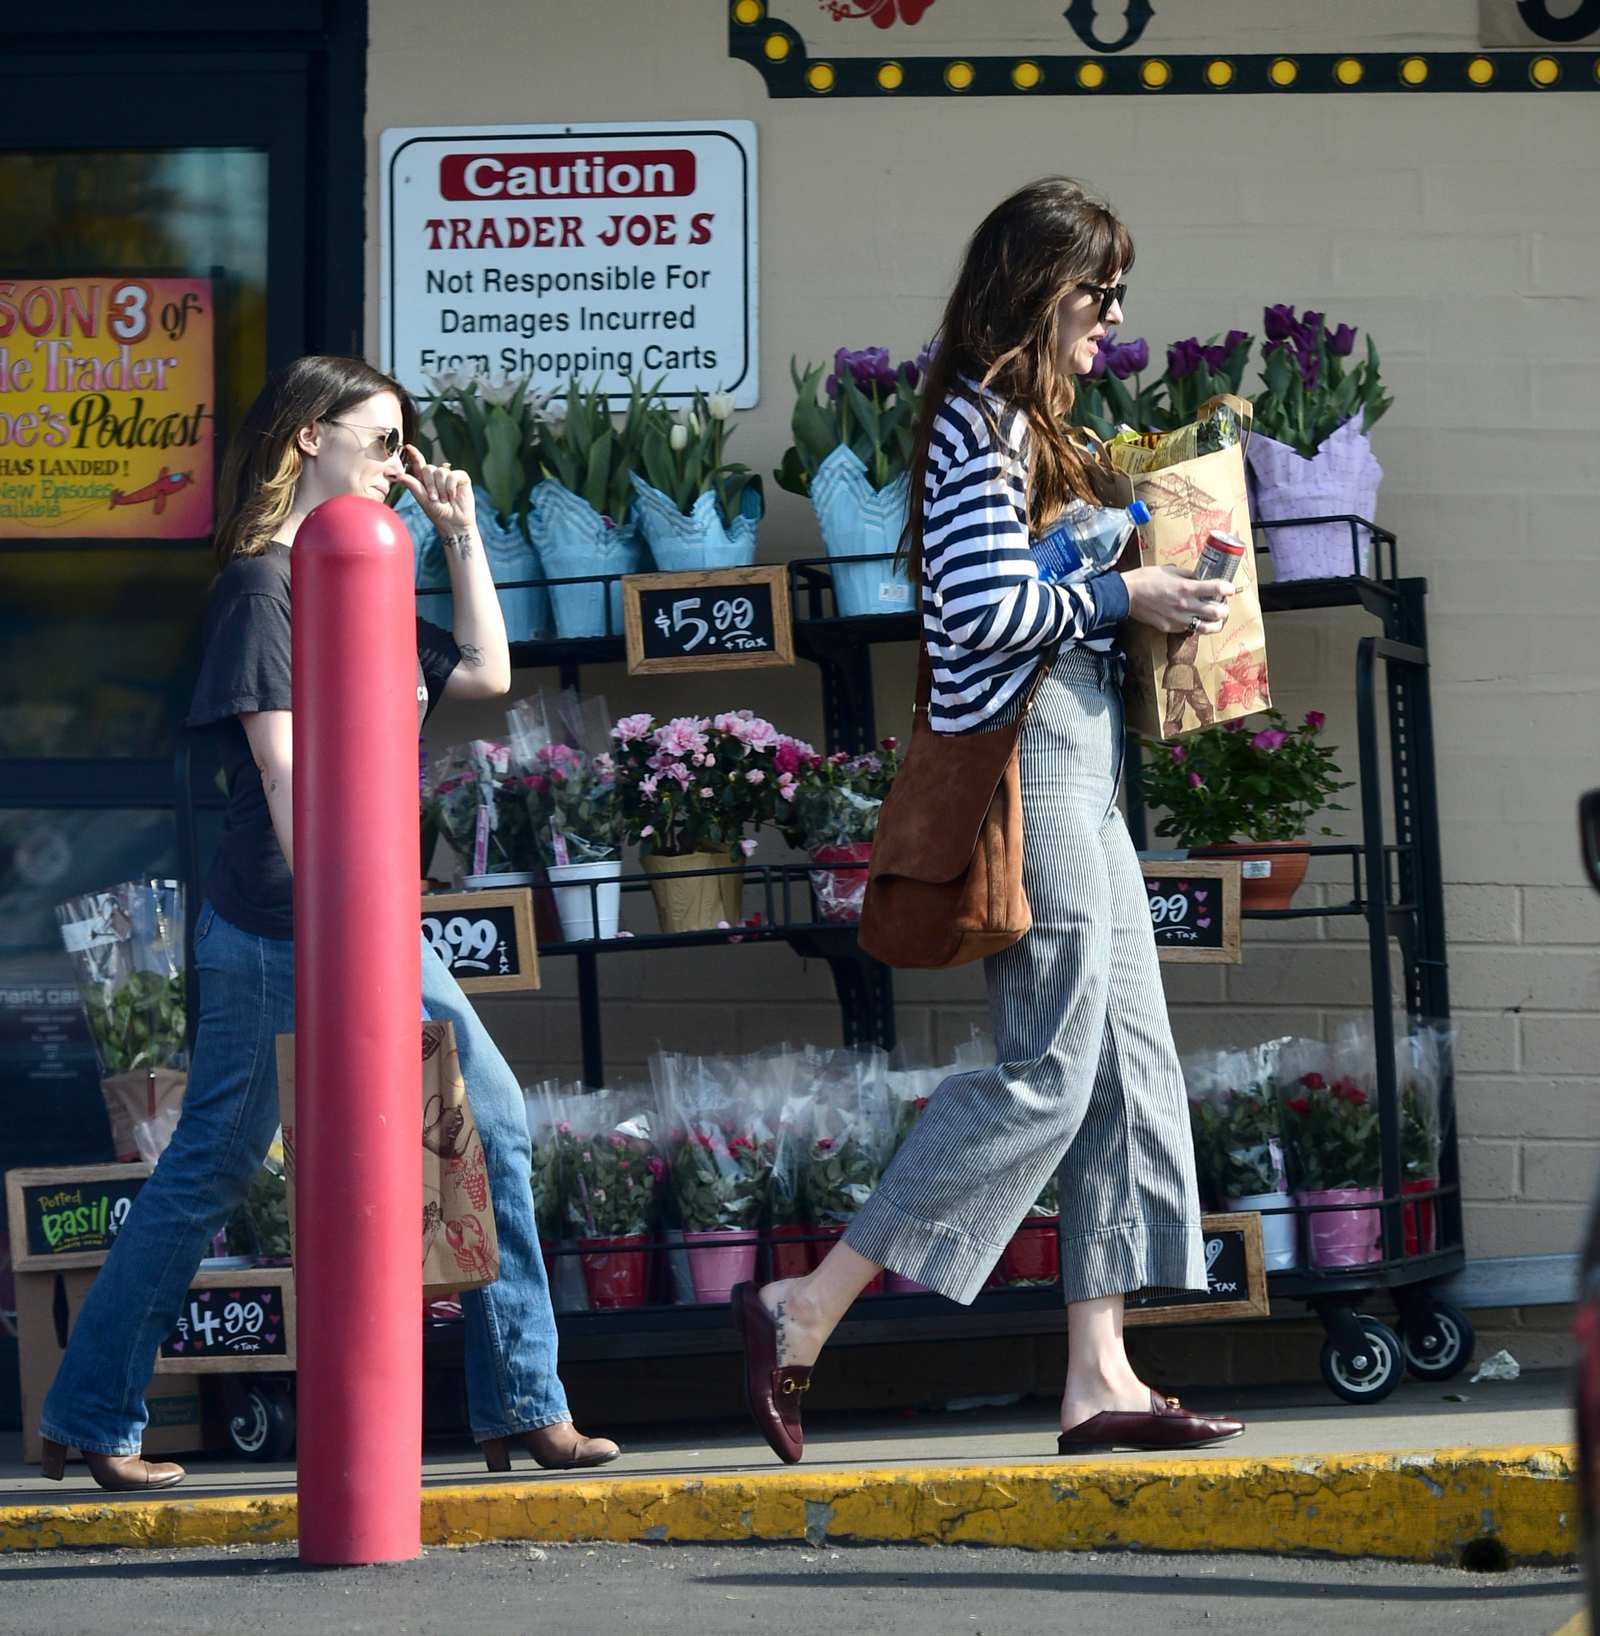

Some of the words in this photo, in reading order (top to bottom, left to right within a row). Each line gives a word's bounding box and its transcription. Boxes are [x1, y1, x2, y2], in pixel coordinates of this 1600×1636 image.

[463, 157, 675, 197] Caution
[423, 217, 586, 250] TRADER
[426, 270, 473, 295] Not
[484, 266, 656, 298] Responsible
[667, 264, 711, 290] For
[112, 285, 148, 339] 3
[161, 292, 203, 341] of
[441, 309, 570, 339] Damages
[581, 304, 697, 331] Incurred
[34, 339, 178, 392] Trader
[421, 349, 489, 374] From
[501, 347, 633, 376] Shopping
[644, 344, 717, 371] Carts
[69, 393, 214, 449] Podcast
[0, 459, 34, 476] HAS
[654, 597, 754, 652] $5.99
[38, 1188, 81, 1213] Potted
[41, 1195, 109, 1246] Basil
[176, 1301, 264, 1346] $4.99
